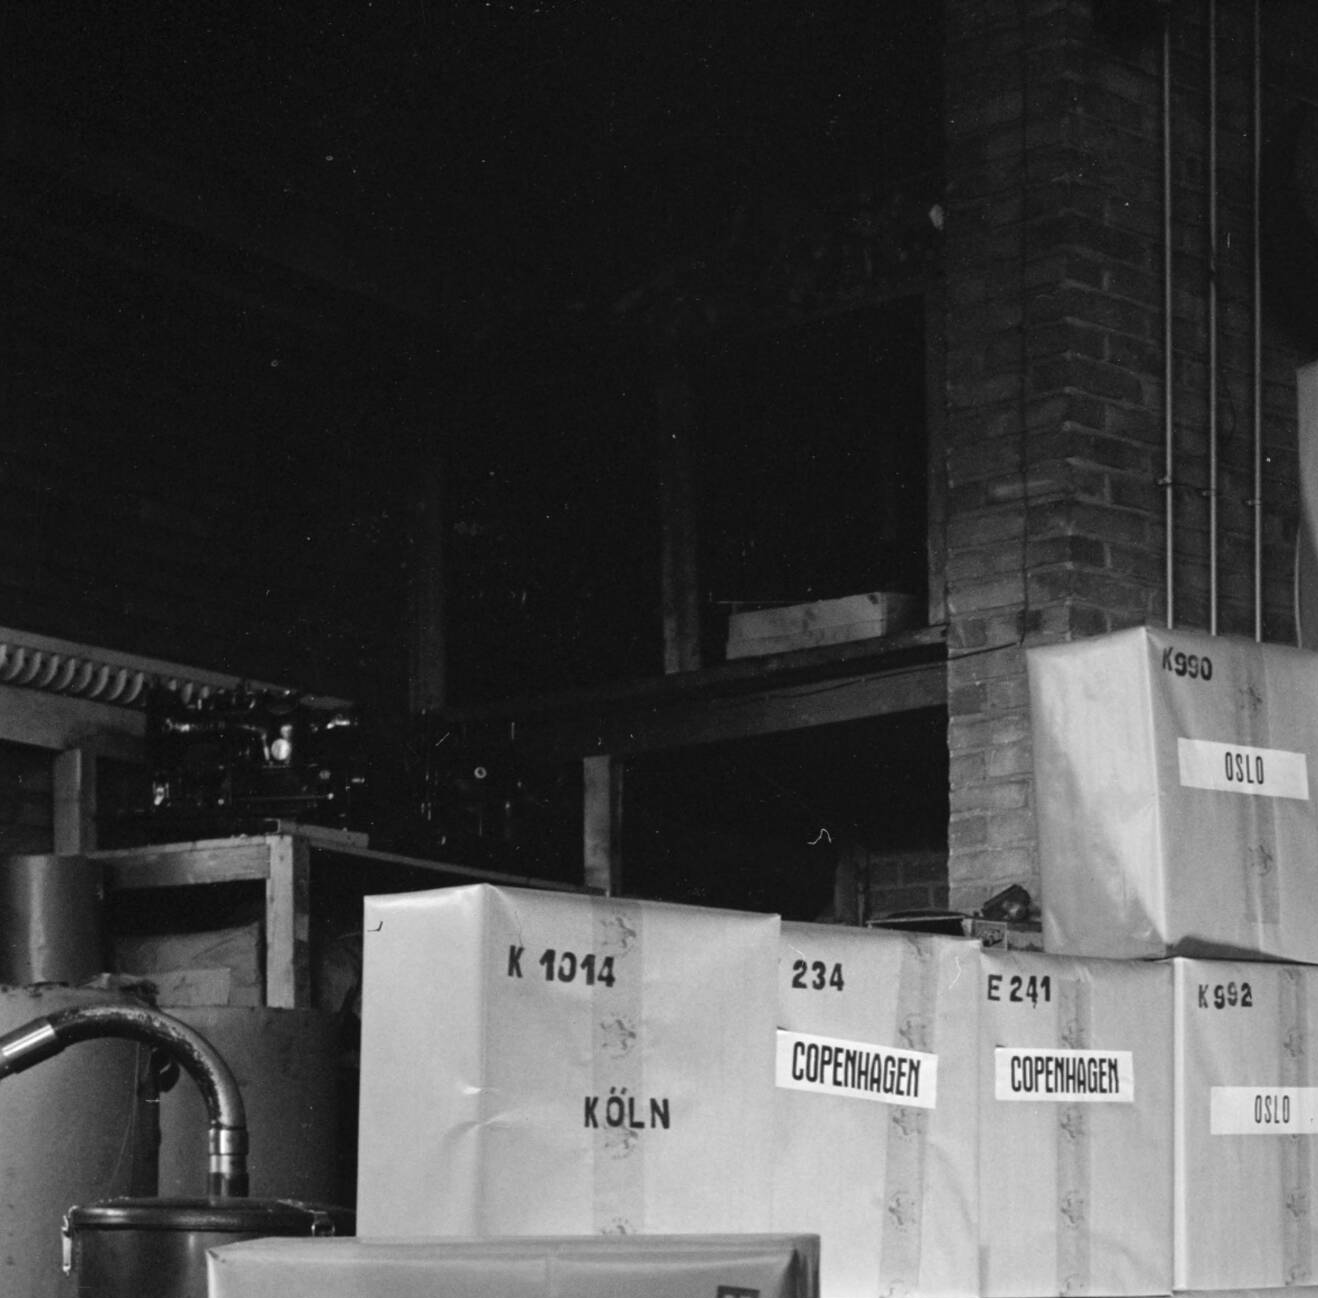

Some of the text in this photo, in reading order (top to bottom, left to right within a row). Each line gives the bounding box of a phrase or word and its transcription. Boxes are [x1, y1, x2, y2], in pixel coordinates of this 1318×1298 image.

[1225, 752, 1264, 785] OSLO
[507, 945, 616, 988] K 1014
[792, 959, 845, 991] 234
[792, 1041, 921, 1098] COPENHAGEN
[1011, 1056, 1119, 1094] COPENHAGEN
[584, 1086, 670, 1130] KÖLN
[1254, 1094, 1290, 1124] OSLO
